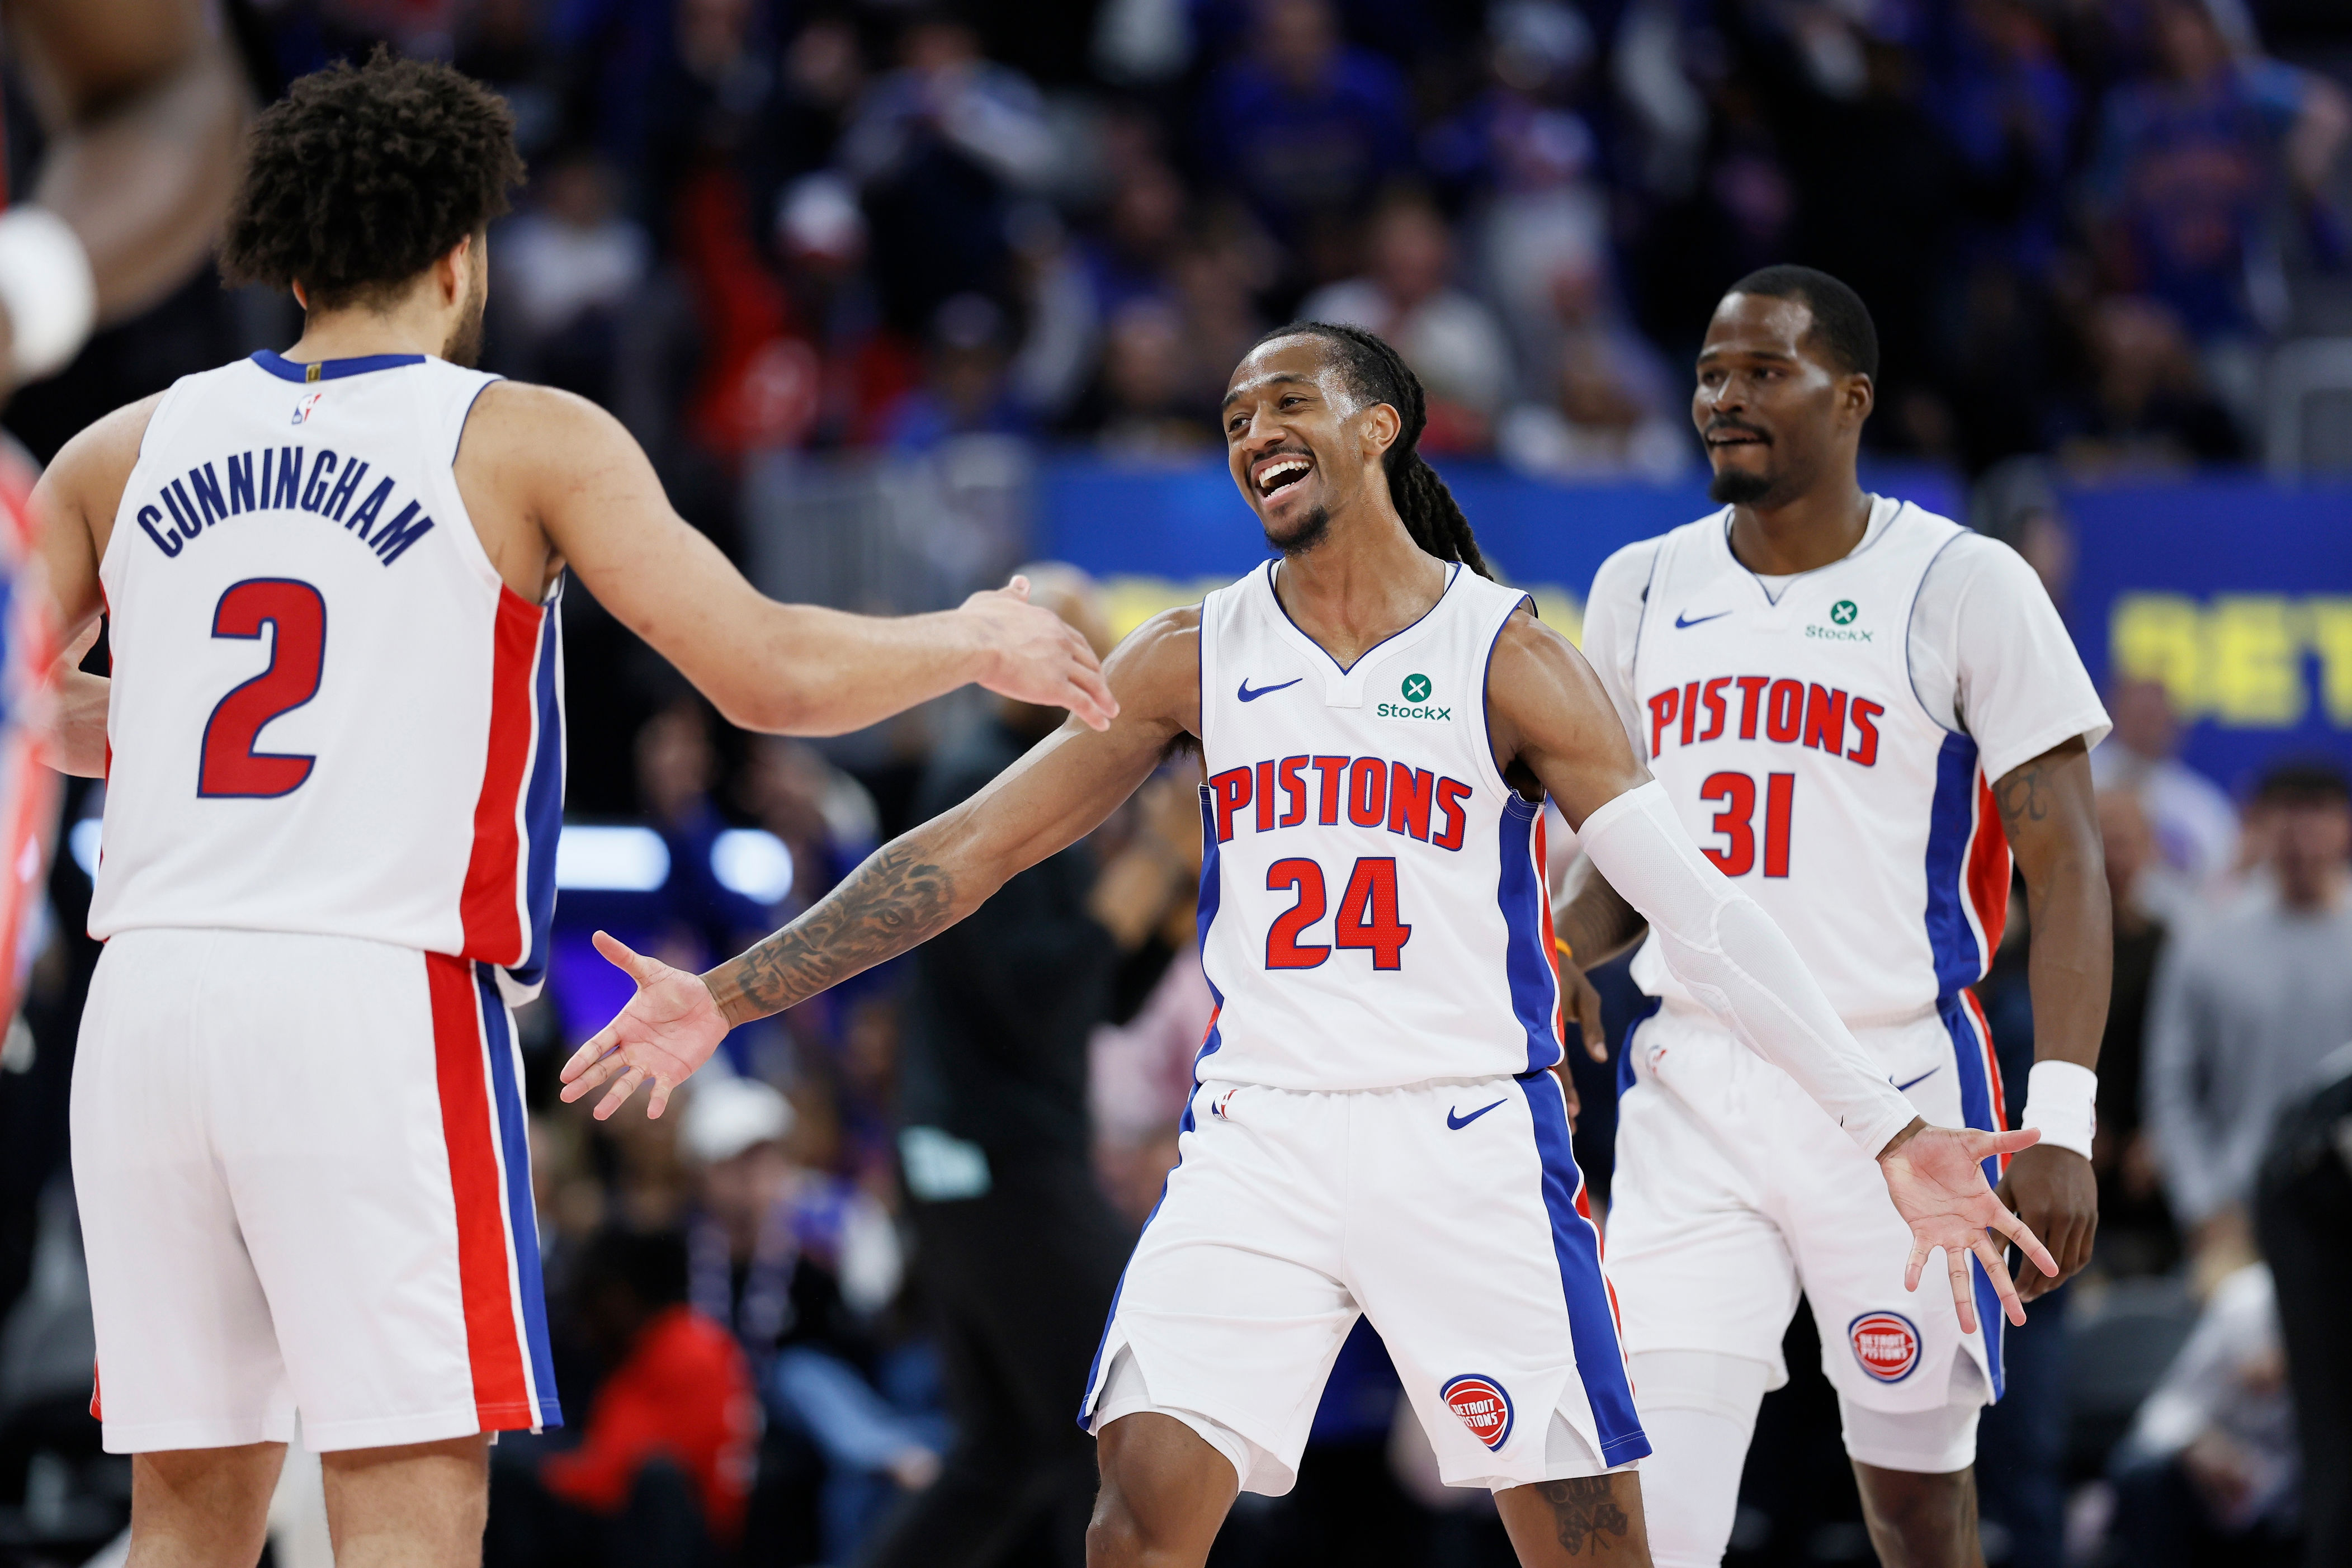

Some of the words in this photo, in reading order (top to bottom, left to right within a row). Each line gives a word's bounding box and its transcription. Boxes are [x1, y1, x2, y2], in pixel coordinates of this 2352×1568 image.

[137, 446, 434, 568] CUNNINGHAM
[1805, 624, 1873, 643] StockX
[197, 578, 327, 799] 2
[1377, 703, 1451, 721] StockX
[1648, 676, 1885, 767] PISTONS
[1209, 755, 1473, 852] PISTONS
[1700, 772, 1795, 879] 31
[1265, 857, 1412, 971] 24
[1451, 1399, 1494, 1415] DETROIT
